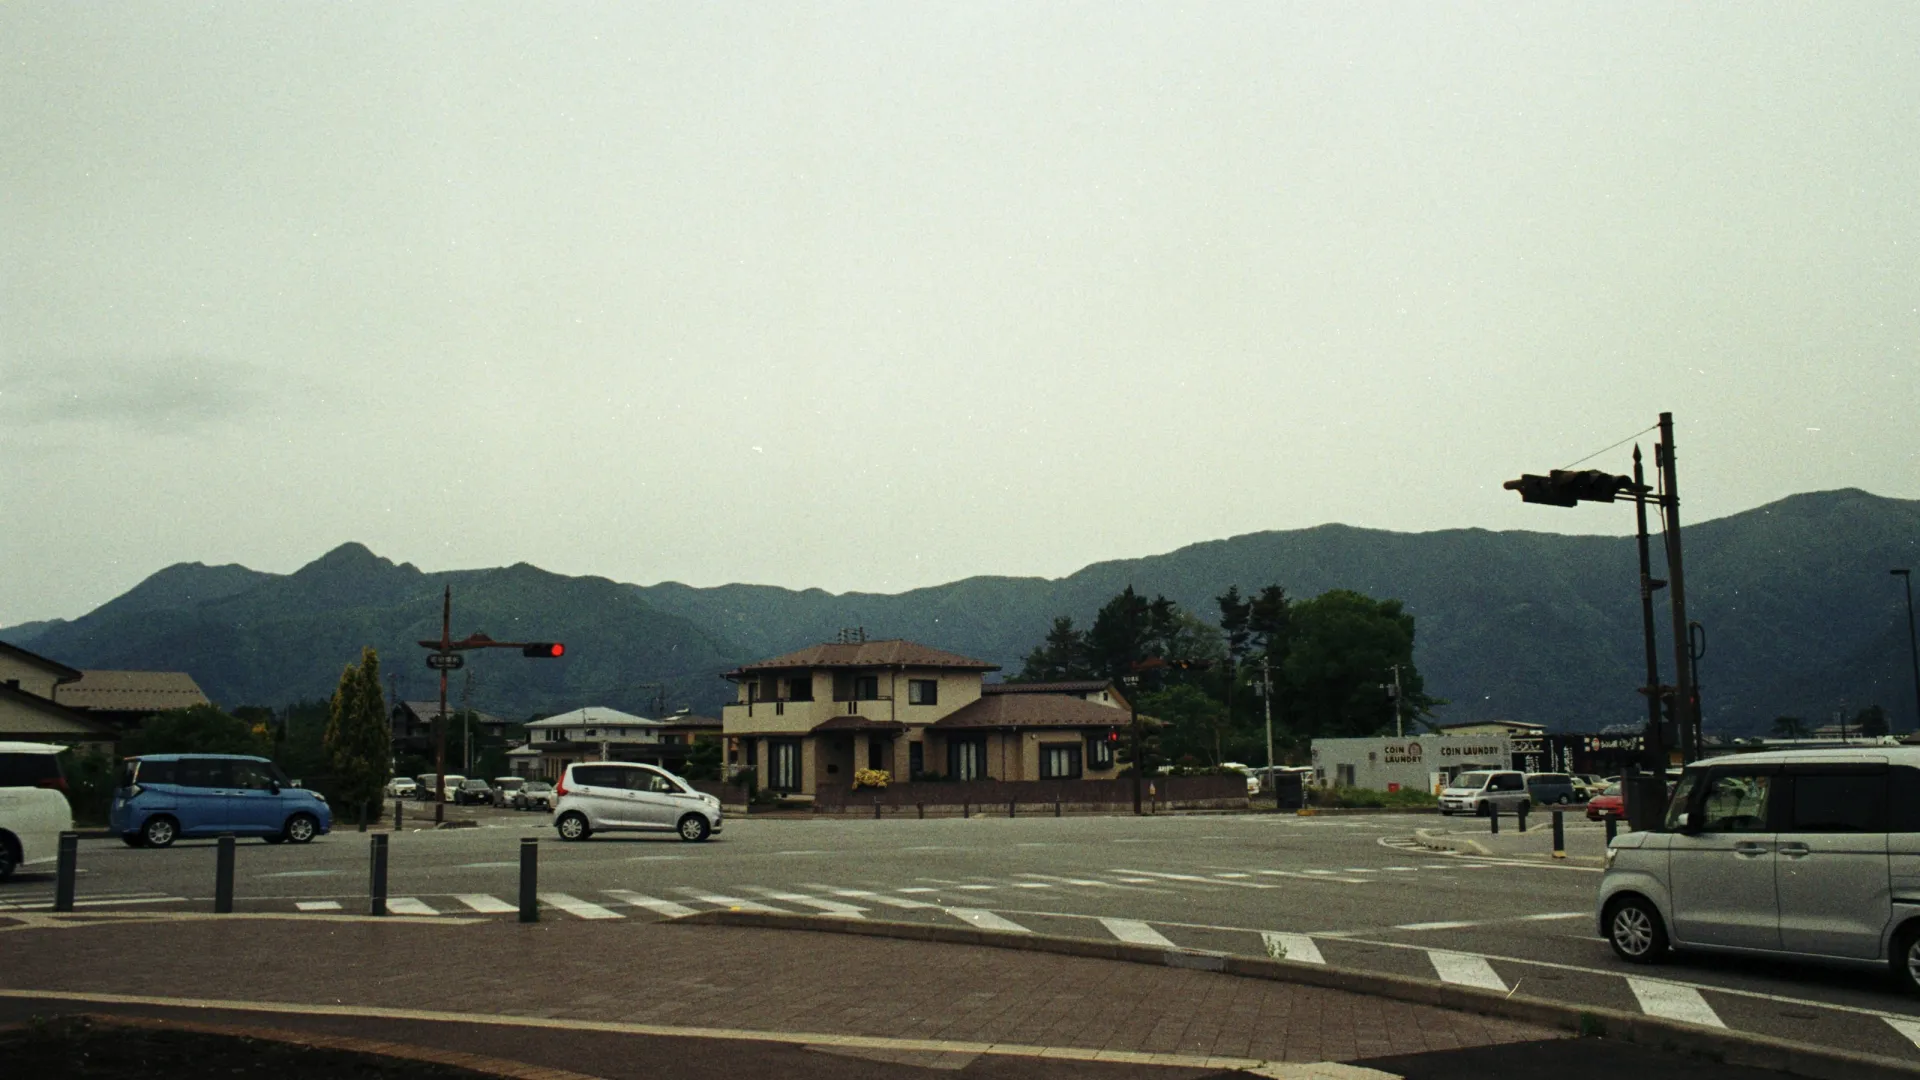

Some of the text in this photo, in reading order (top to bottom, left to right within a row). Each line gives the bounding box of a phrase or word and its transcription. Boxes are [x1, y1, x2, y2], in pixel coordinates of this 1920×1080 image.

[1384, 746, 1405, 754] COIN
[1441, 747, 1461, 756] COIN
[1463, 746, 1499, 756] LAUNDRY
